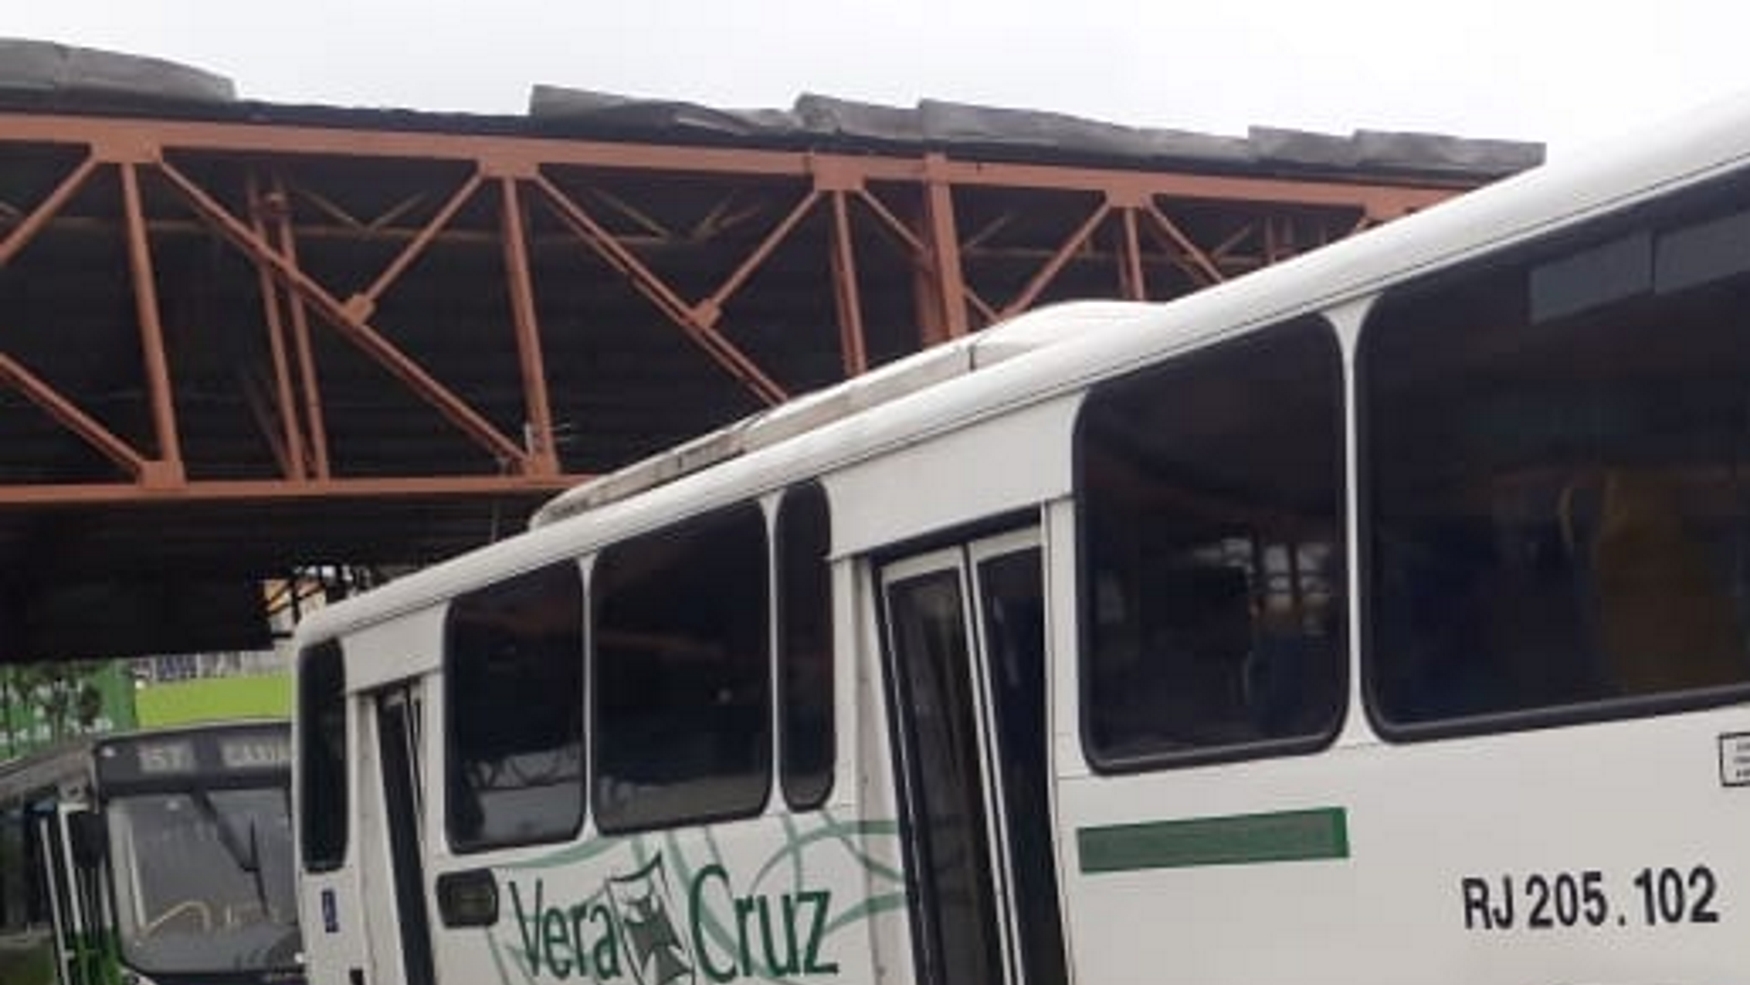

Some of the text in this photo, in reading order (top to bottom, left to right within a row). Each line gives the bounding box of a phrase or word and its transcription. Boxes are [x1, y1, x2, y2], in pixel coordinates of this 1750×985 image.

[508, 864, 839, 984] Vera Cruz
[1461, 876, 1515, 930] RJ
